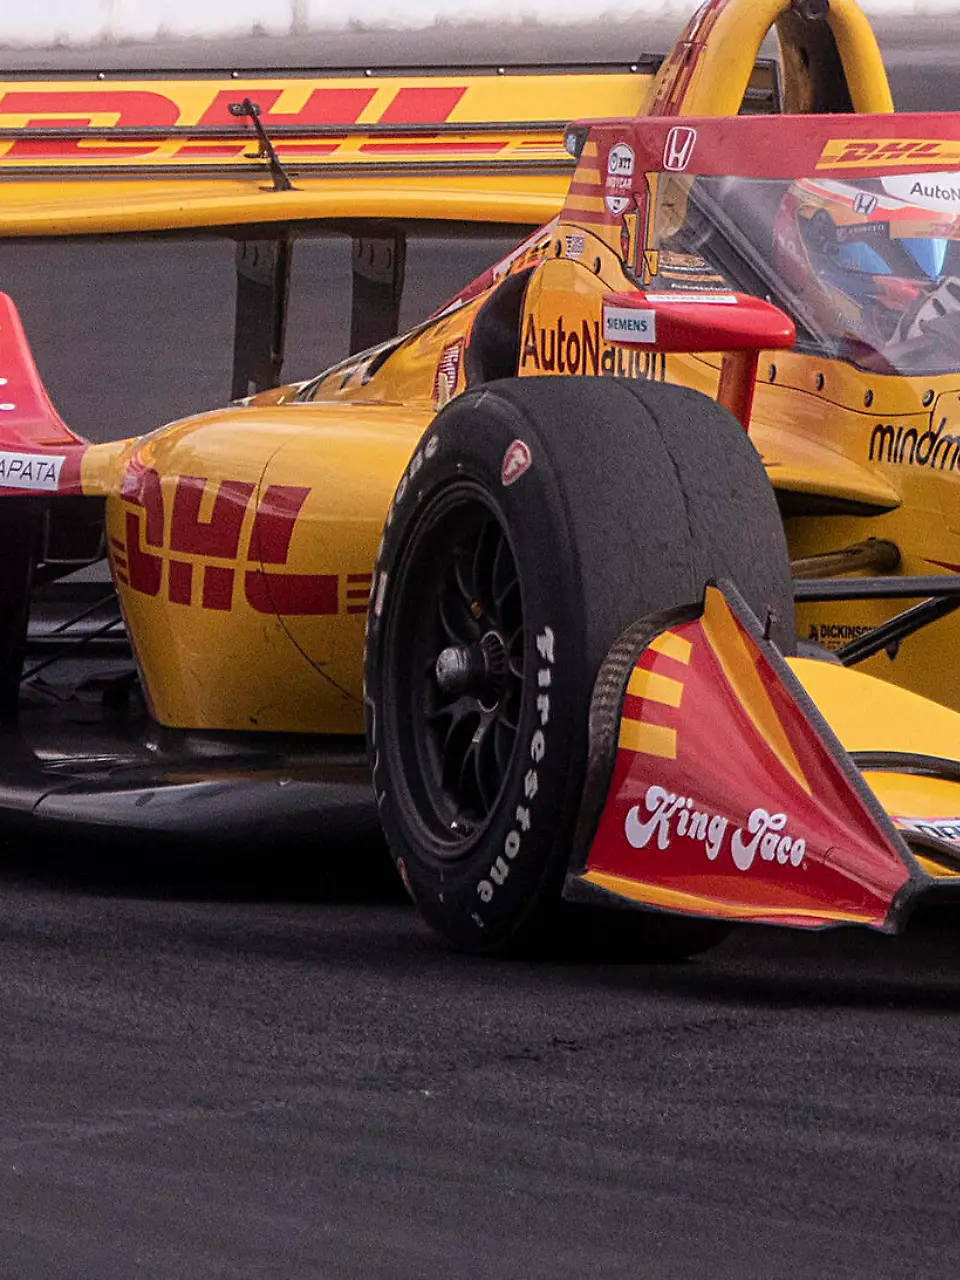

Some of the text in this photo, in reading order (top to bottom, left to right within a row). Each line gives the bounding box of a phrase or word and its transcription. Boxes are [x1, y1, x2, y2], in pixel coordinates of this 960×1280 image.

[836, 142, 943, 163] DHL
[606, 318, 648, 332] SIEMENS
[120, 468, 339, 616] DHL
[476, 625, 556, 904] Firestone
[624, 785, 806, 871] King Taco
